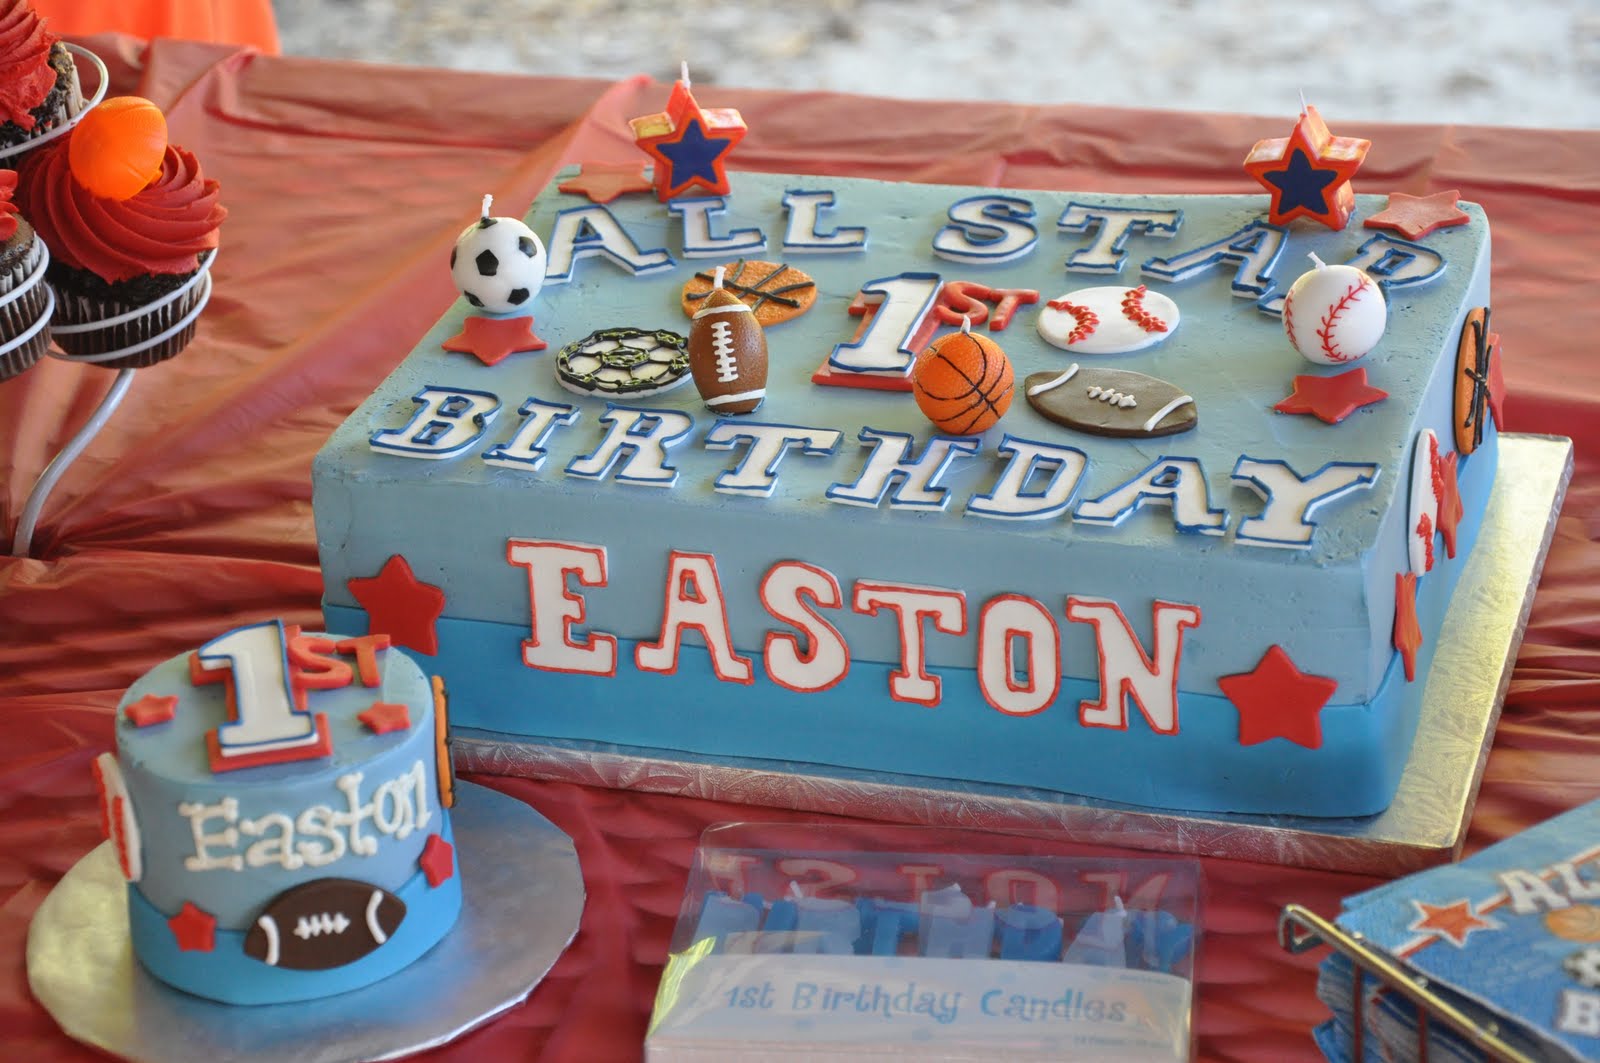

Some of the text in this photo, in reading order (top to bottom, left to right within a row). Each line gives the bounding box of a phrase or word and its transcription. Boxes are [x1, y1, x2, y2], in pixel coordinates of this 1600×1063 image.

[543, 188, 869, 287] ALL
[812, 271, 1041, 392] 1ST
[368, 384, 1382, 550] BIRTHDAY
[188, 618, 392, 774] 1ST
[505, 535, 1203, 736] EASTON
[178, 759, 433, 872] Easton
[723, 977, 1127, 1025] 1st Birthday Candles
